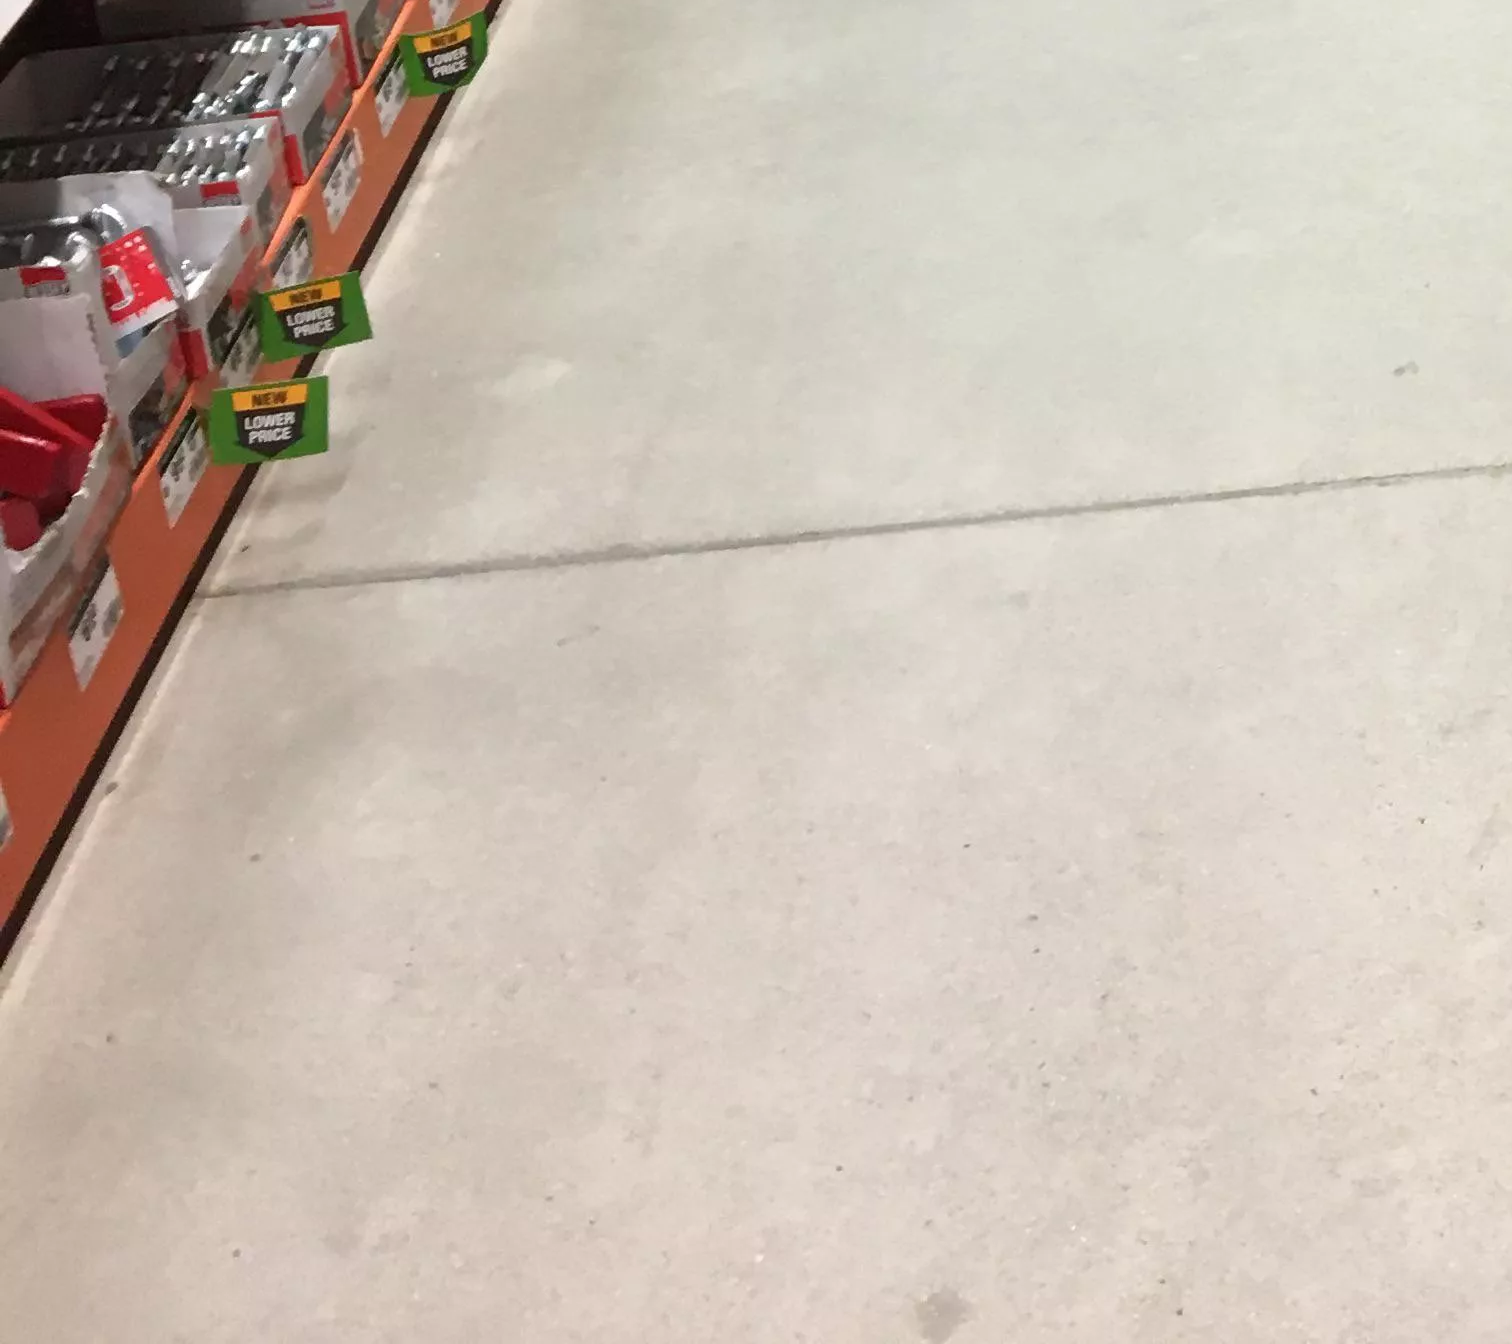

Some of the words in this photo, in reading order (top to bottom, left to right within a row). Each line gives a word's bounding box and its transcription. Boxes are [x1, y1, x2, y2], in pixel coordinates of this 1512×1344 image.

[427, 46, 468, 68] LOWER
[432, 58, 468, 78] PRICE
[289, 288, 323, 304] NEW
[286, 305, 336, 326] LOWER
[294, 319, 335, 338] PRICE
[251, 391, 288, 408] NEW
[244, 411, 296, 430] LOWER
[249, 426, 293, 445] PRICE
